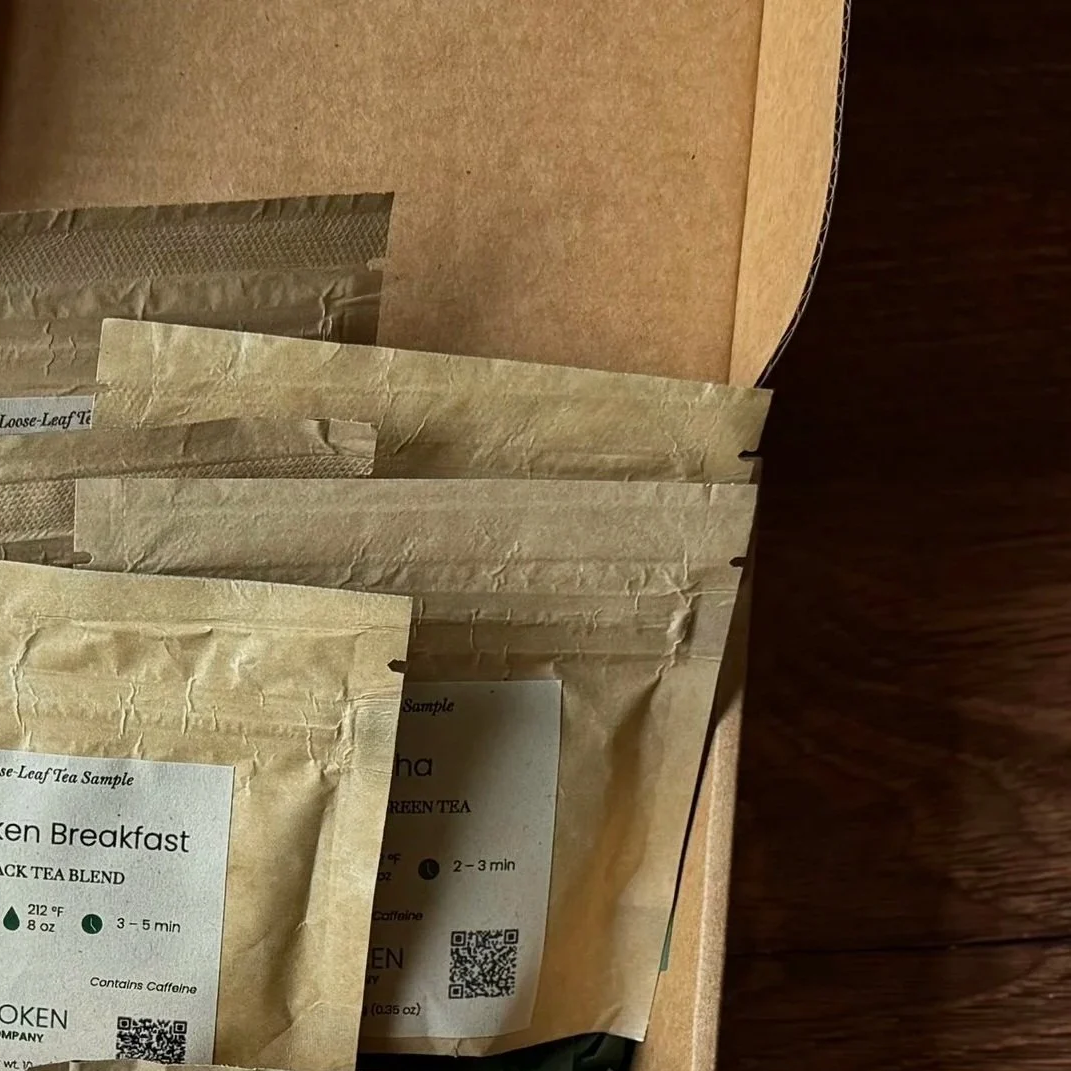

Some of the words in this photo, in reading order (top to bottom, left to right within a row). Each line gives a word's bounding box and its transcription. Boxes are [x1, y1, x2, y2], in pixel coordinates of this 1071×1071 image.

[76, 411, 92, 426] Te
[402, 698, 455, 714] Sample
[52, 767, 78, 784] Tea
[80, 770, 135, 790] Sample
[388, 800, 433, 814] REEN
[436, 800, 471, 814] TEA
[51, 822, 190, 853] Breakfast
[453, 860, 461, 872] 2
[477, 859, 486, 871] 3
[489, 858, 516, 871] min
[30, 865, 66, 881] TEA
[68, 868, 126, 885] BLEND
[27, 903, 48, 917] 212
[373, 909, 423, 922] Caffeine
[39, 922, 56, 933] oz
[154, 920, 181, 933] min
[89, 976, 144, 991] Contains
[146, 981, 198, 995] Caffeine
[370, 1003, 400, 1016] (0.35
[403, 1003, 421, 1016] oz)
